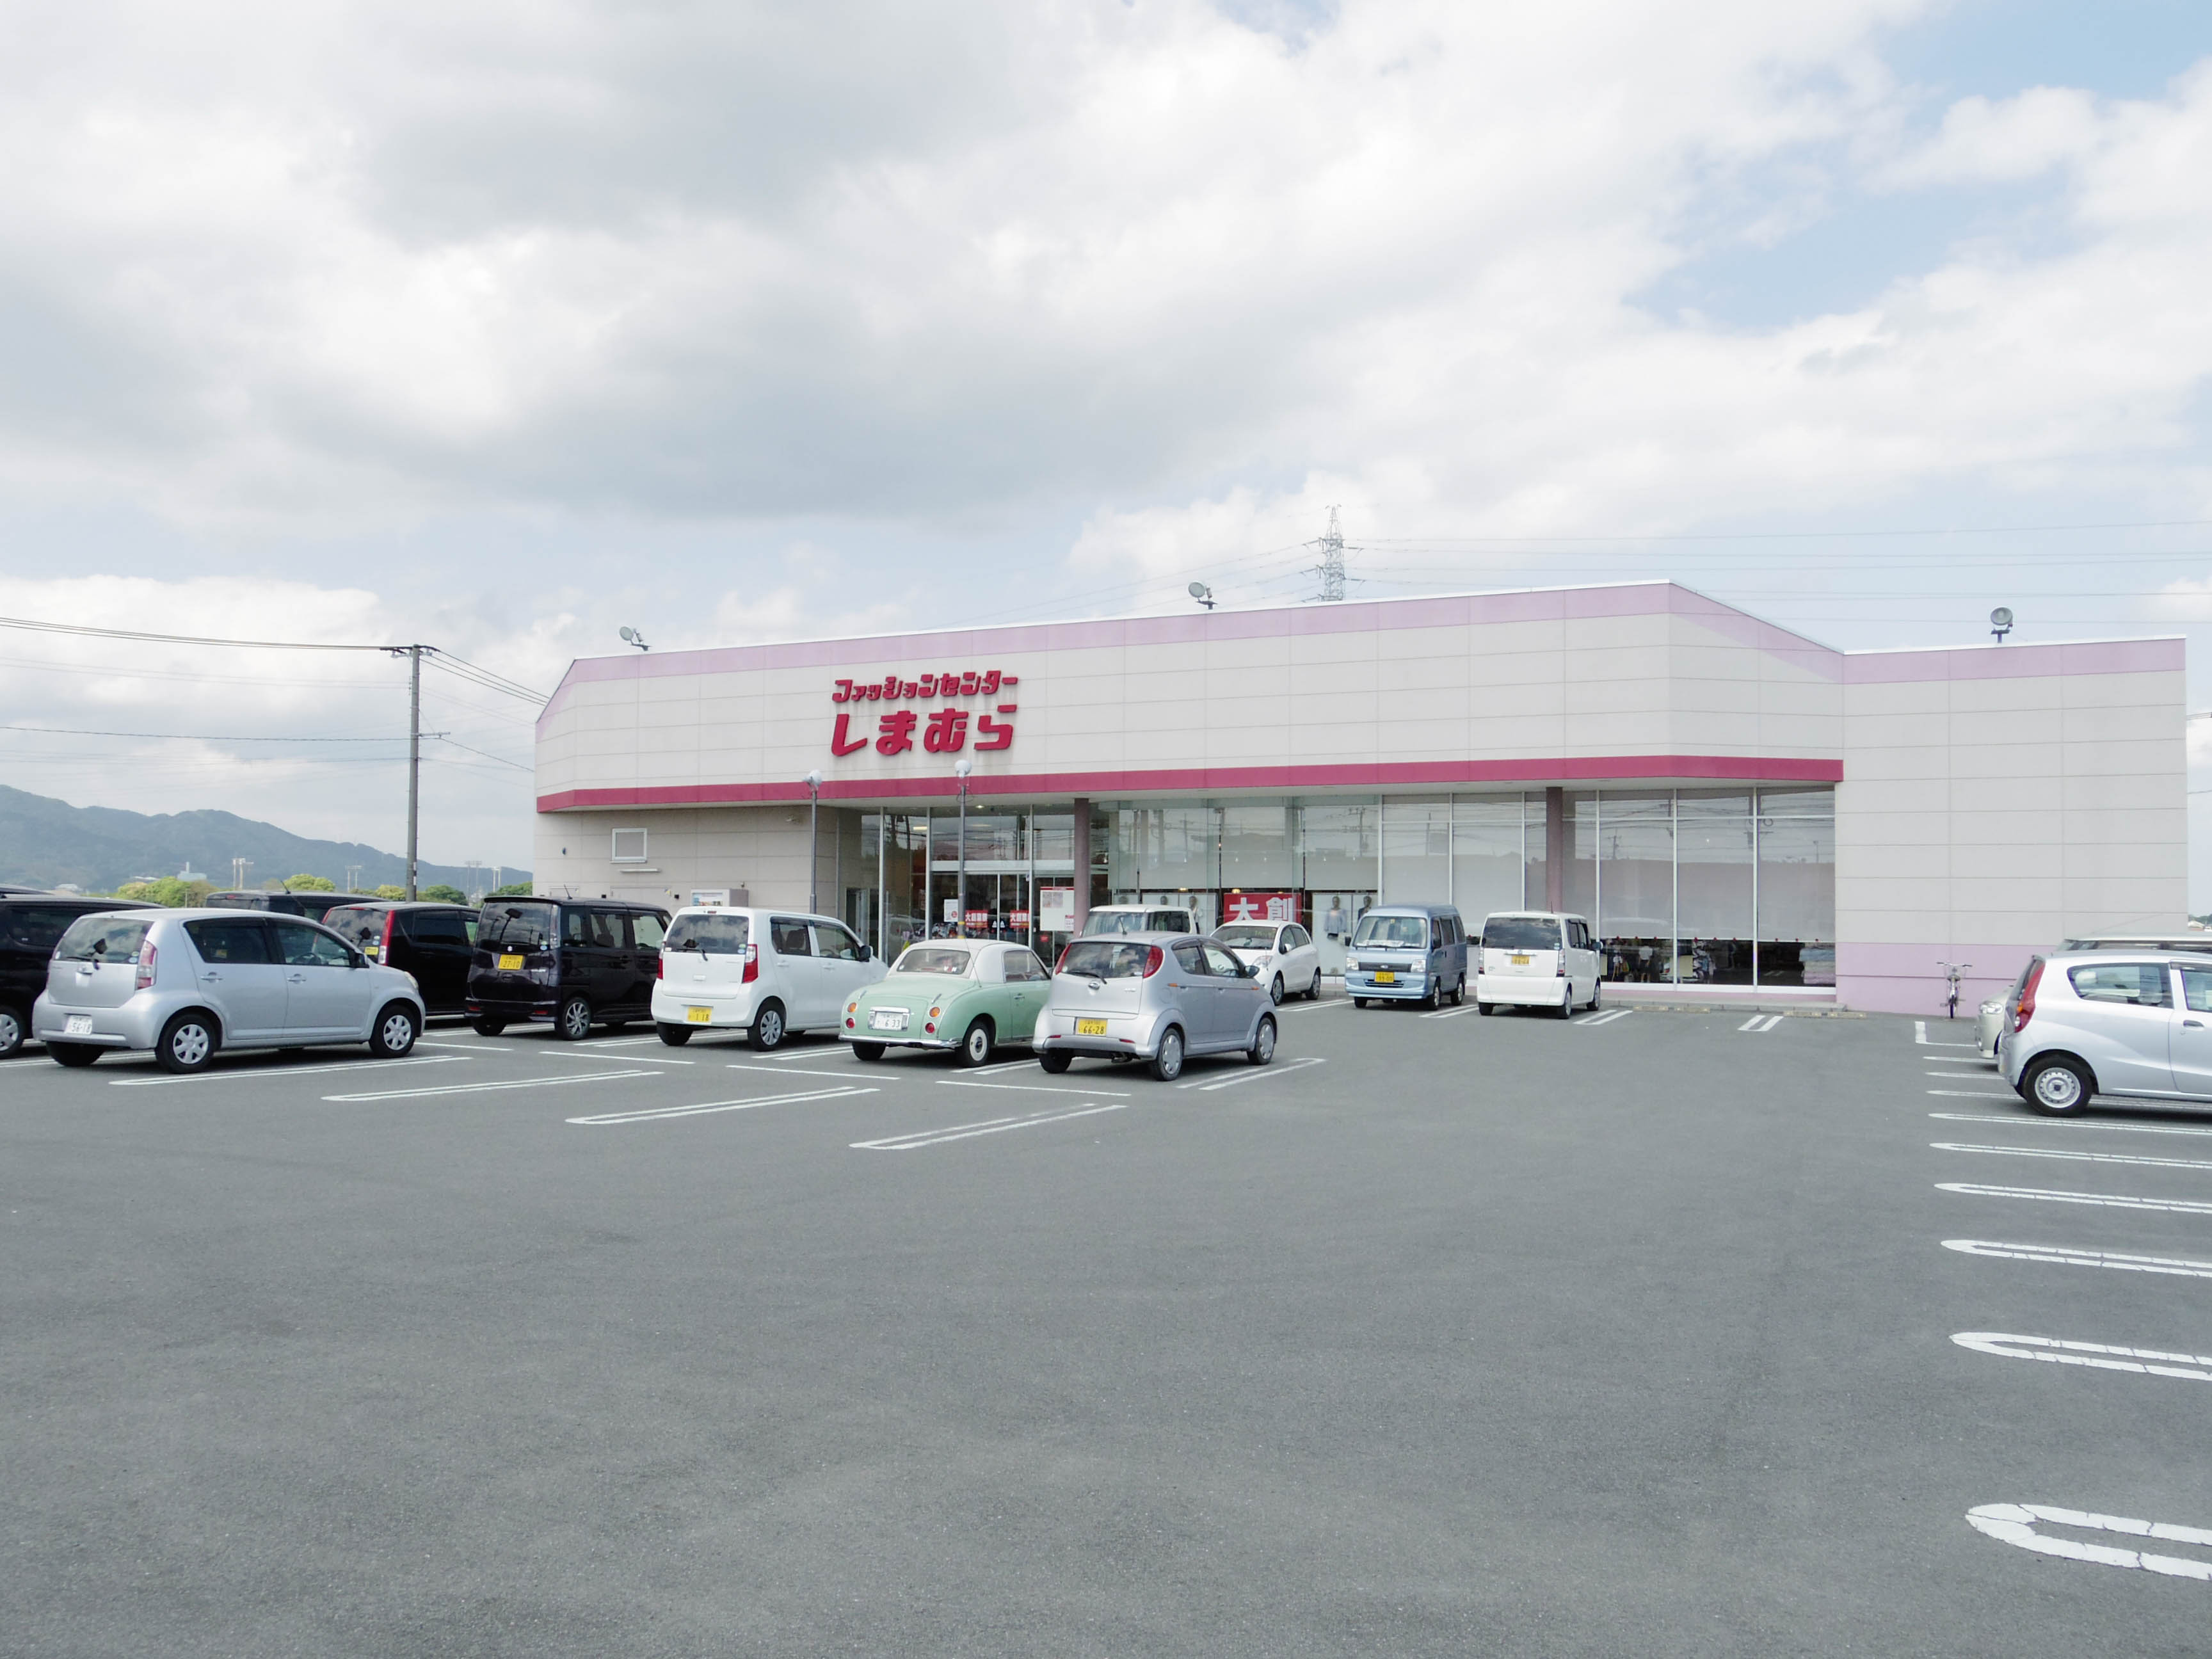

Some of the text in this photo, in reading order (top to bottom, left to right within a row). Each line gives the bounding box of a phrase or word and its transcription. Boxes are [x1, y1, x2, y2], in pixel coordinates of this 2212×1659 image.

[832, 670, 1018, 703] ファッションセンター
[831, 704, 1018, 757] しまむら
[1229, 897, 1295, 922] 大創
[1084, 1025, 1105, 1034] 66-28
